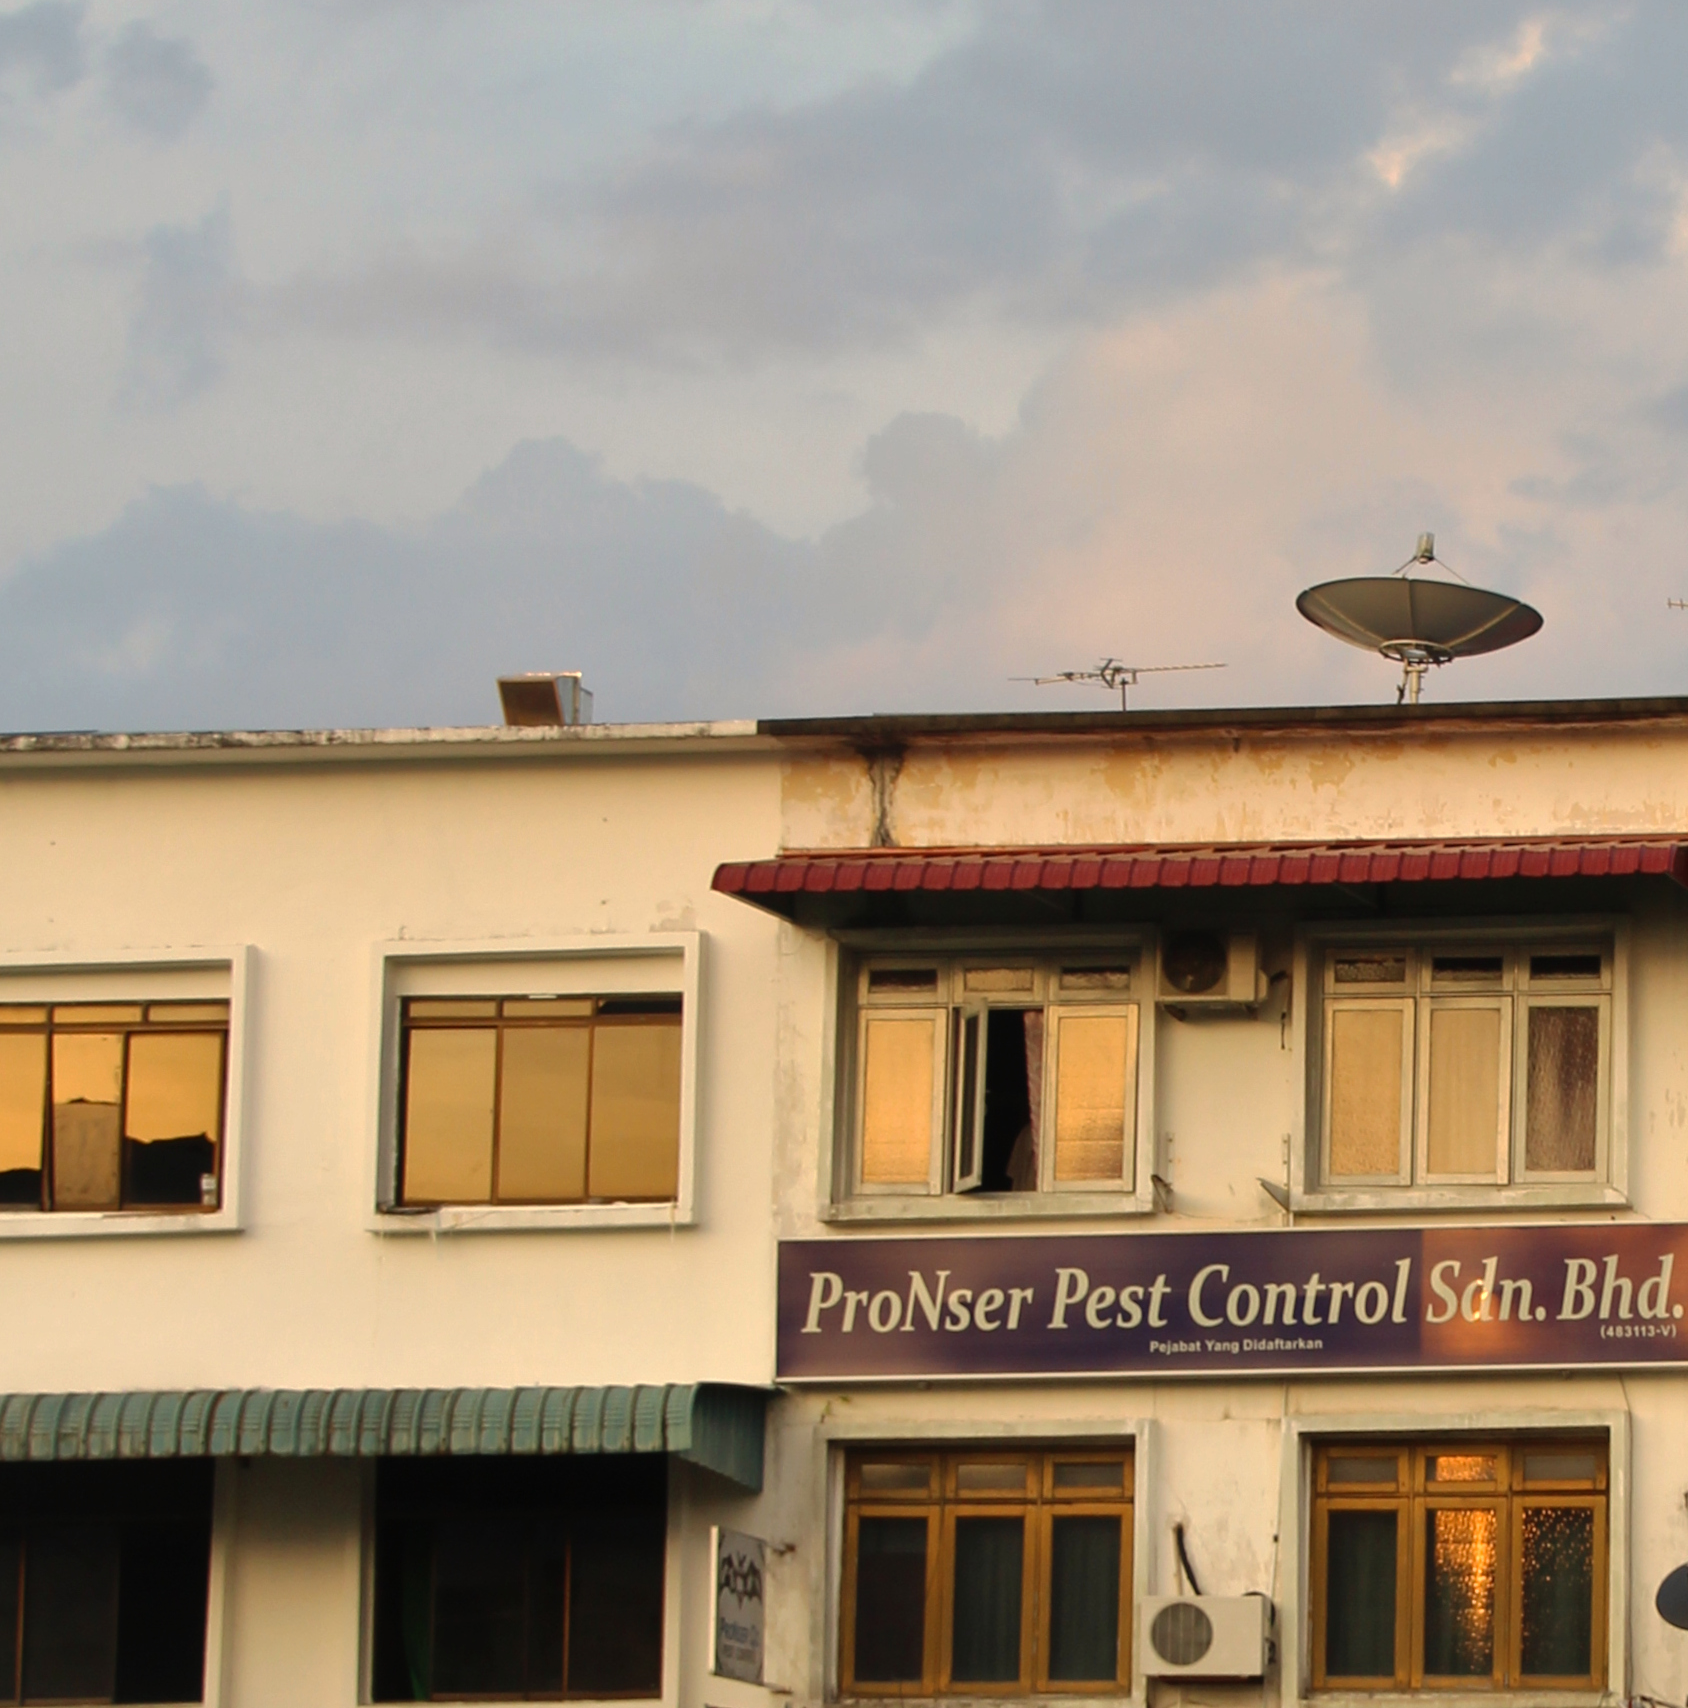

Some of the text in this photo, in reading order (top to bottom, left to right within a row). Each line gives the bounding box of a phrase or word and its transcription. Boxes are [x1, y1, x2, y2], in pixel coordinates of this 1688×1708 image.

[800, 1252, 1685, 1333] ProNser Pest Control Sdn. Bhd.
[1600, 1323, 1677, 1339] (483113-V)
[1149, 1337, 1323, 1356] Pejabat Yang Didaftarkan
